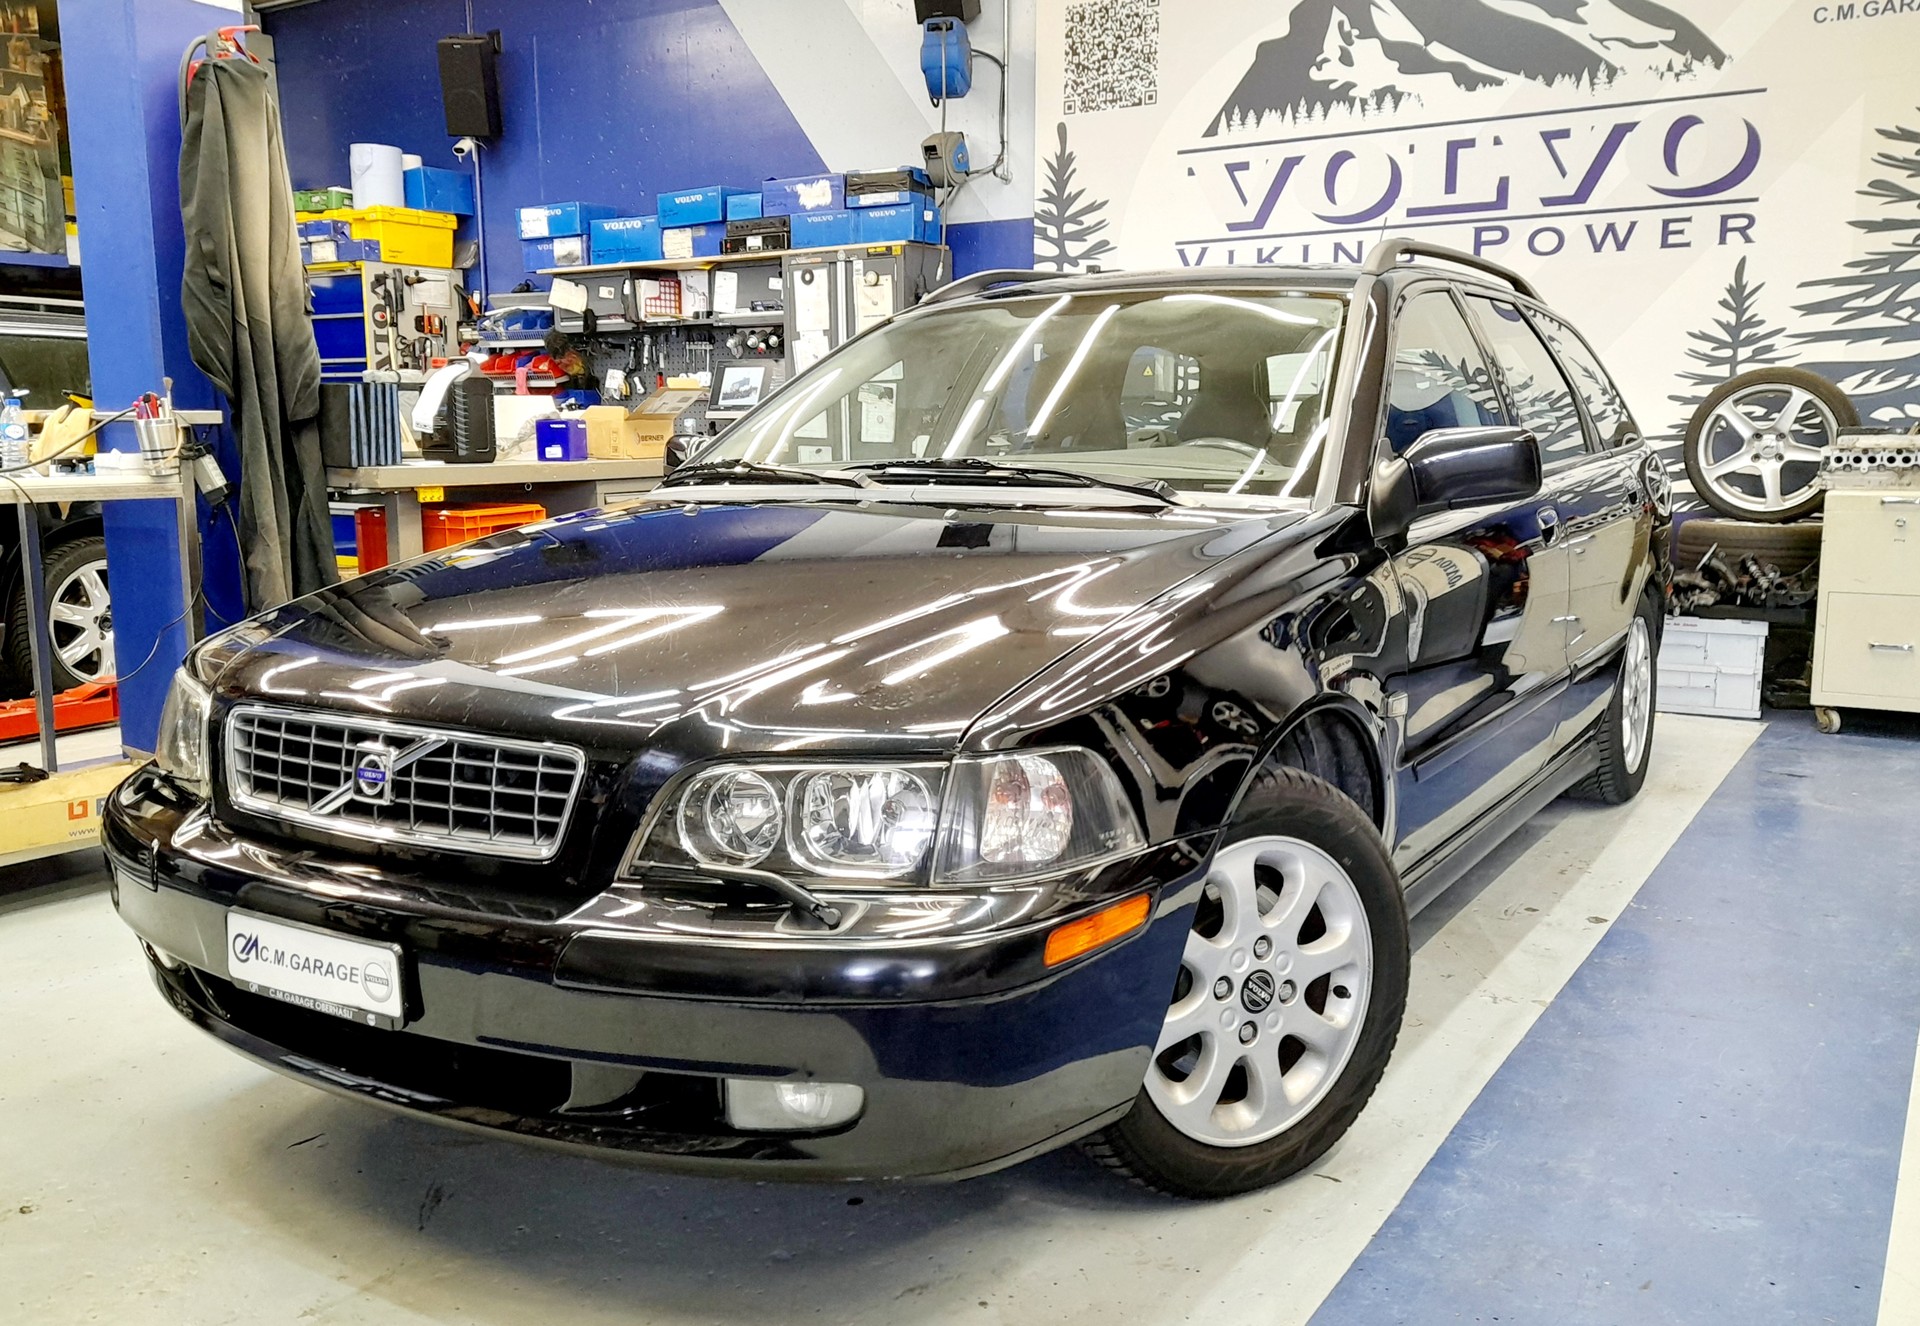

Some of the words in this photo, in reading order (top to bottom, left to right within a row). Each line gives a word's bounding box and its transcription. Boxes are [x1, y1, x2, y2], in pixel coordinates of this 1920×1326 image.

[1813, 0, 1920, 24] C.M.GAR
[1187, 110, 1762, 232] VOLVO
[674, 194, 703, 205] VOLVO
[807, 214, 834, 224] VOLVO
[869, 209, 896, 218] VOLVO
[603, 220, 641, 231] VOLVO
[1176, 239, 1416, 268] VIKIN
[1471, 211, 1756, 258] POWER
[640, 434, 665, 443] BERNER
[359, 770, 383, 780] VOLVO
[260, 945, 360, 984] C.M.GARAGE
[365, 975, 388, 986] VOLVO
[1248, 980, 1271, 1002] VOLVO
